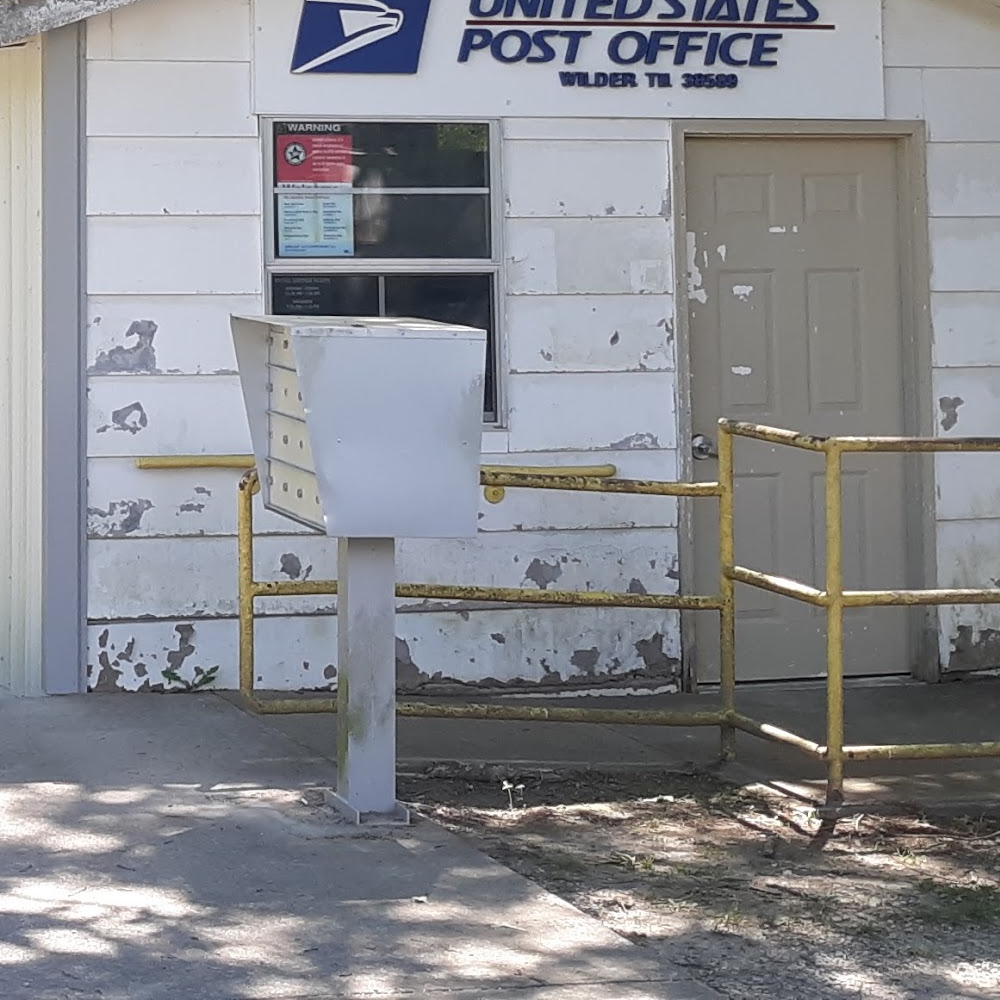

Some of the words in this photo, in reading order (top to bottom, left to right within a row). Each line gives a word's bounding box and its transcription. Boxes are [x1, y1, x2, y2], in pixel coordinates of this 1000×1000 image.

[457, 28, 592, 64] POST
[607, 30, 784, 67] OFFICE
[286, 123, 341, 132] WARNING
